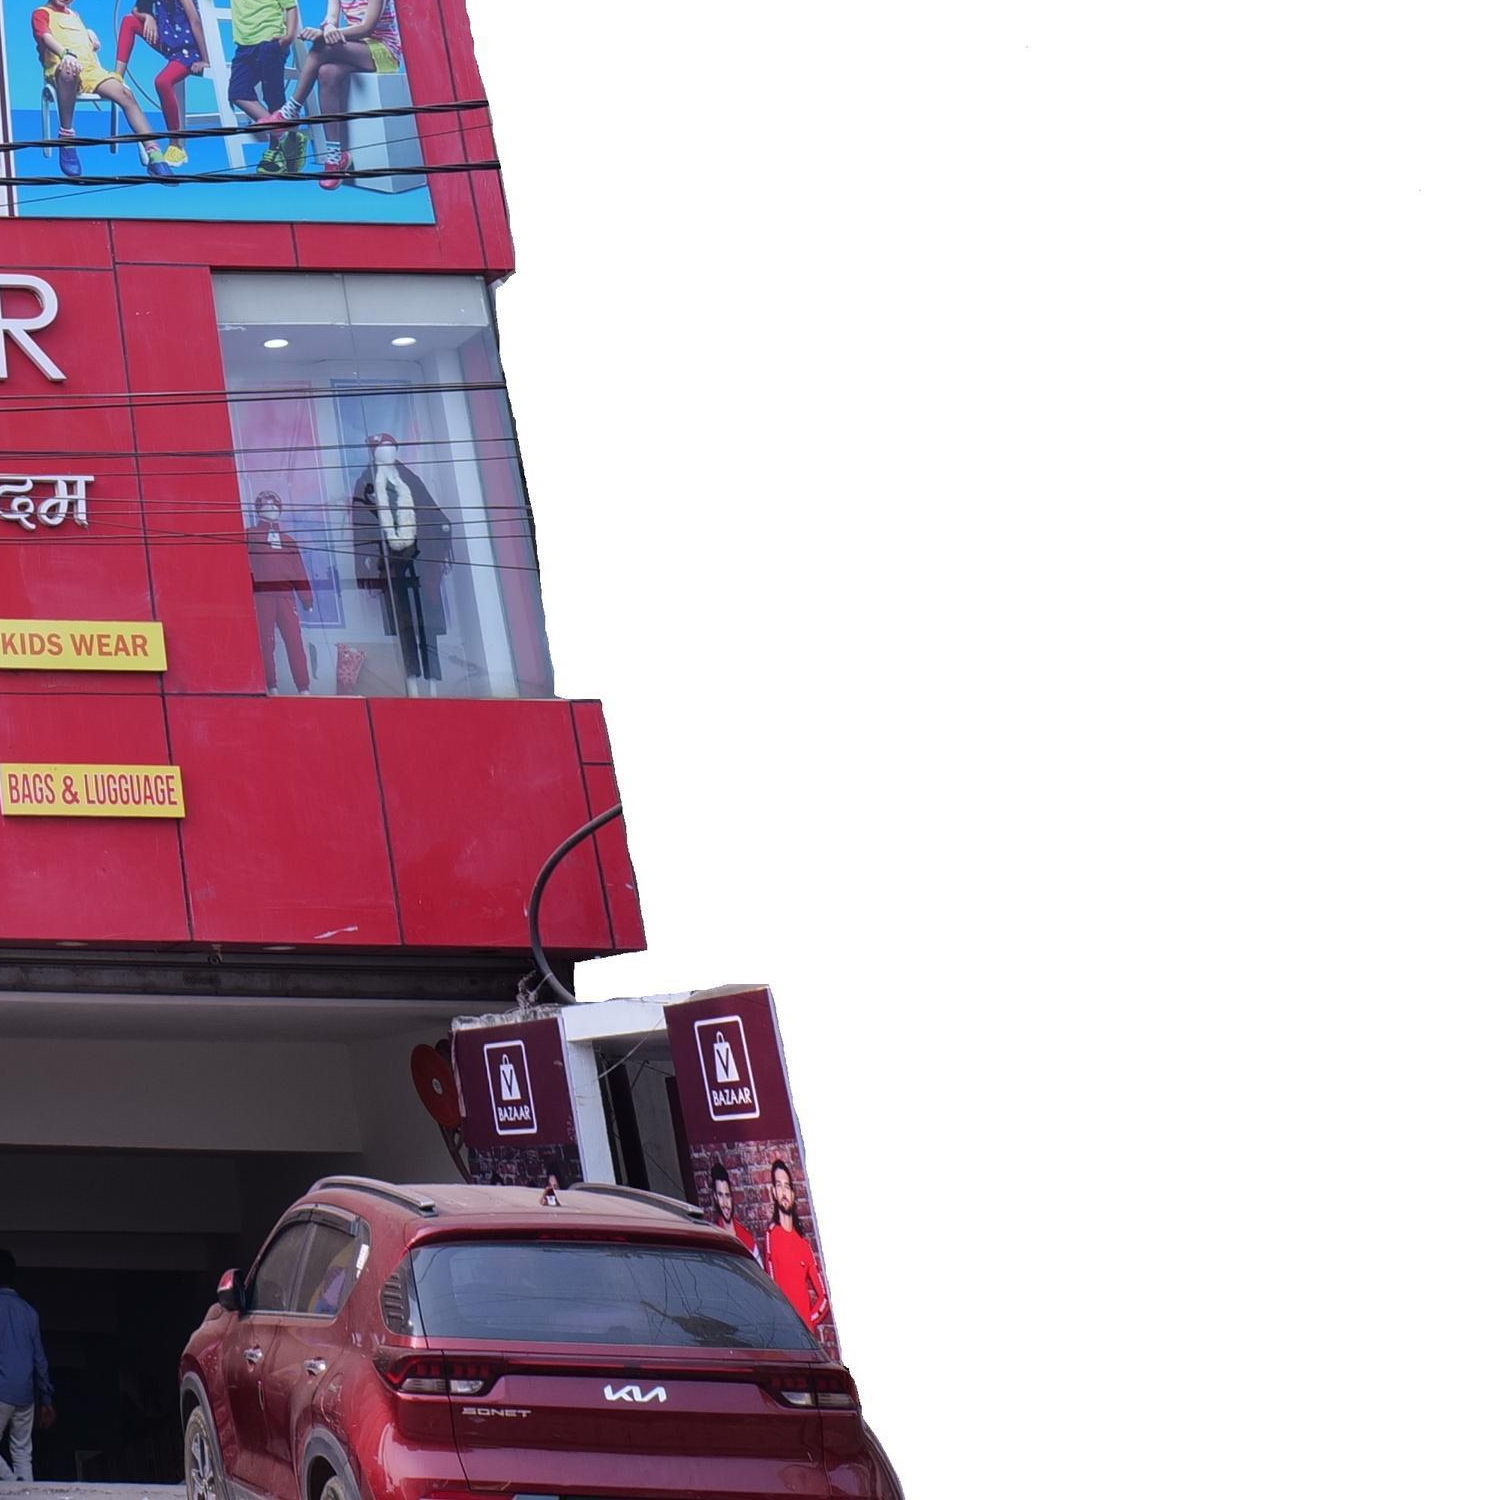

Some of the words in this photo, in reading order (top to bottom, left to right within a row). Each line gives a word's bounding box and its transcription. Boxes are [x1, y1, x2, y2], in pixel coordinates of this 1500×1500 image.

[1, 632, 63, 656] KIDS
[70, 633, 148, 657] WEAR
[8, 772, 56, 804] BAGS
[62, 775, 80, 802] &
[86, 774, 178, 806] LUGGUAGE
[712, 1087, 752, 1106] BAZAAR
[498, 1106, 531, 1121] BAZAAR
[462, 1407, 532, 1418] SONET
